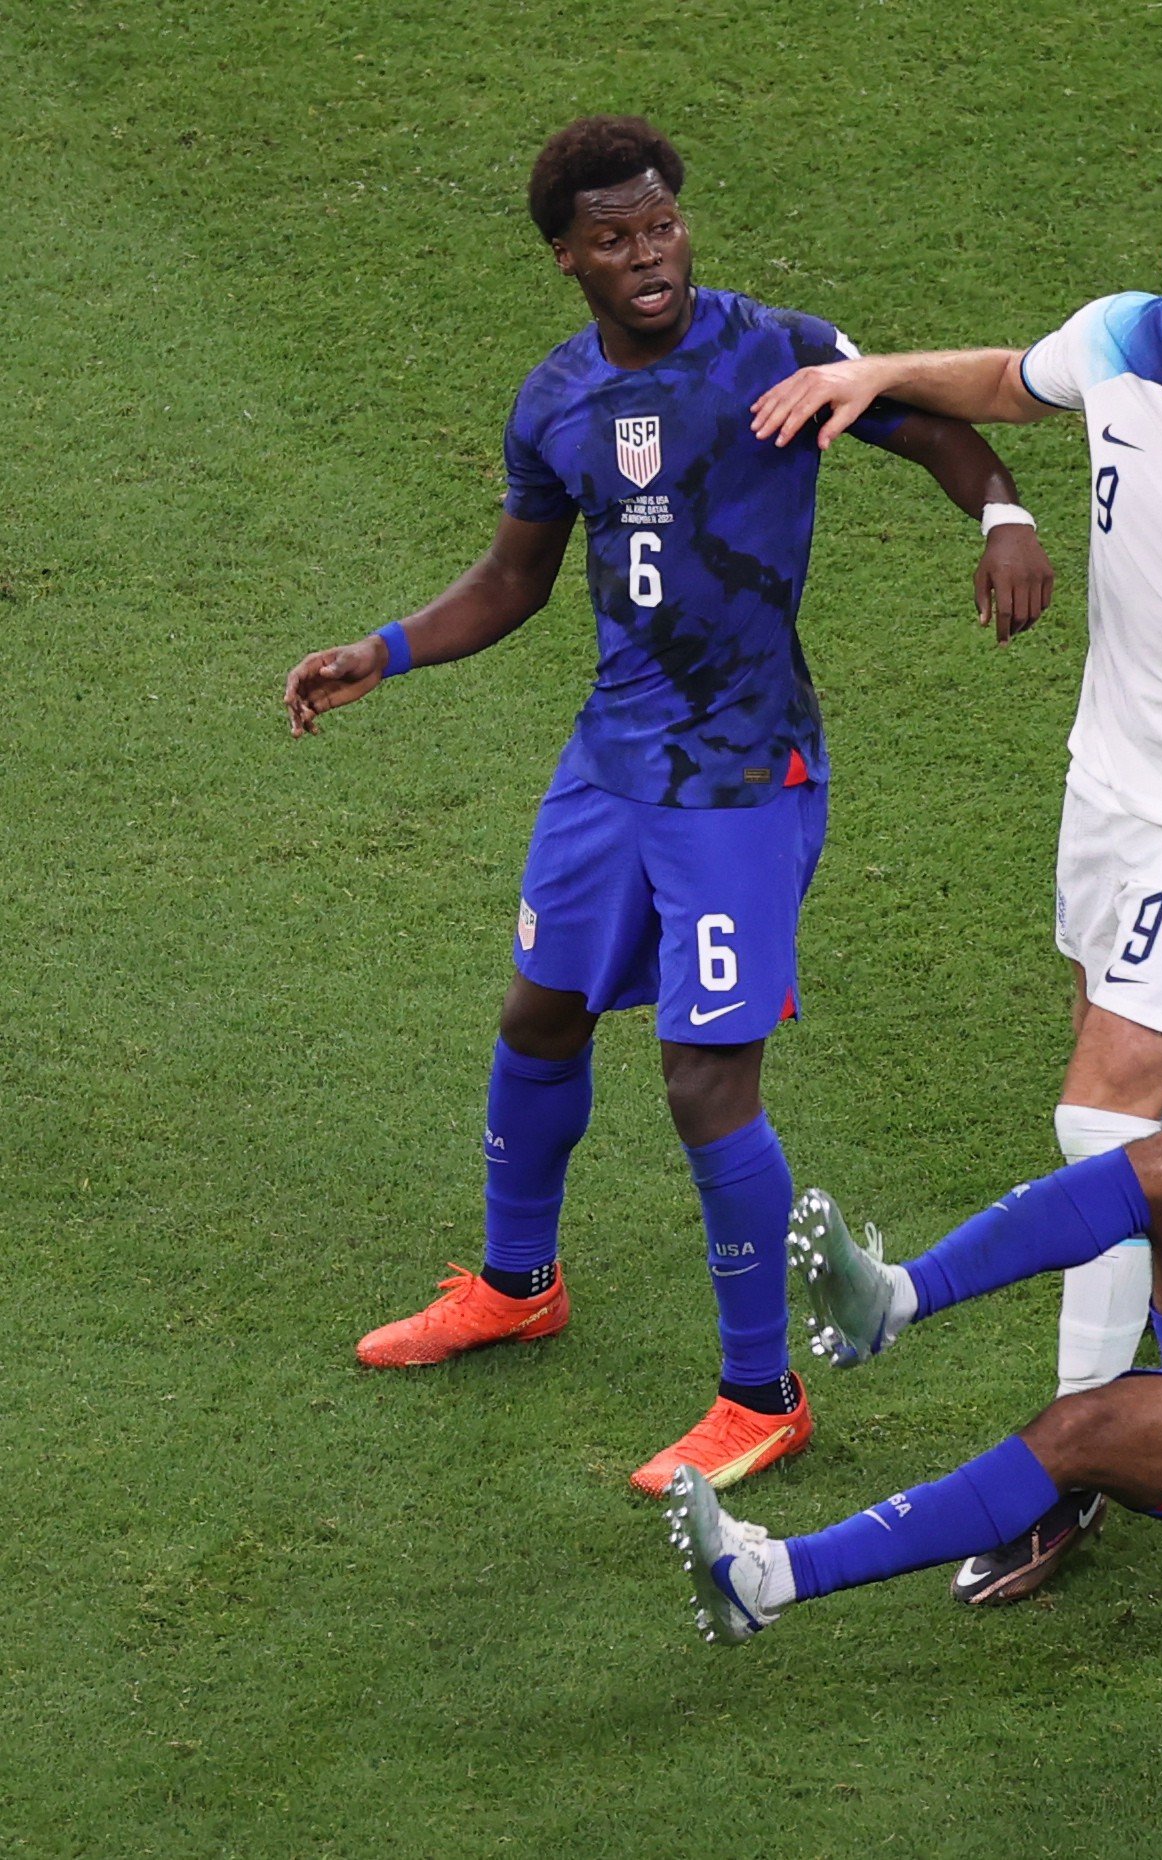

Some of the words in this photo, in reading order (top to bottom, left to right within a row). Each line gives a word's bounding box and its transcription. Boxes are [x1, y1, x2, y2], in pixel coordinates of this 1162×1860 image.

[618, 420, 657, 447] USA
[1095, 465, 1119, 534] 9
[629, 531, 663, 608] 6
[696, 913, 738, 992] 6
[715, 1241, 756, 1258] USA
